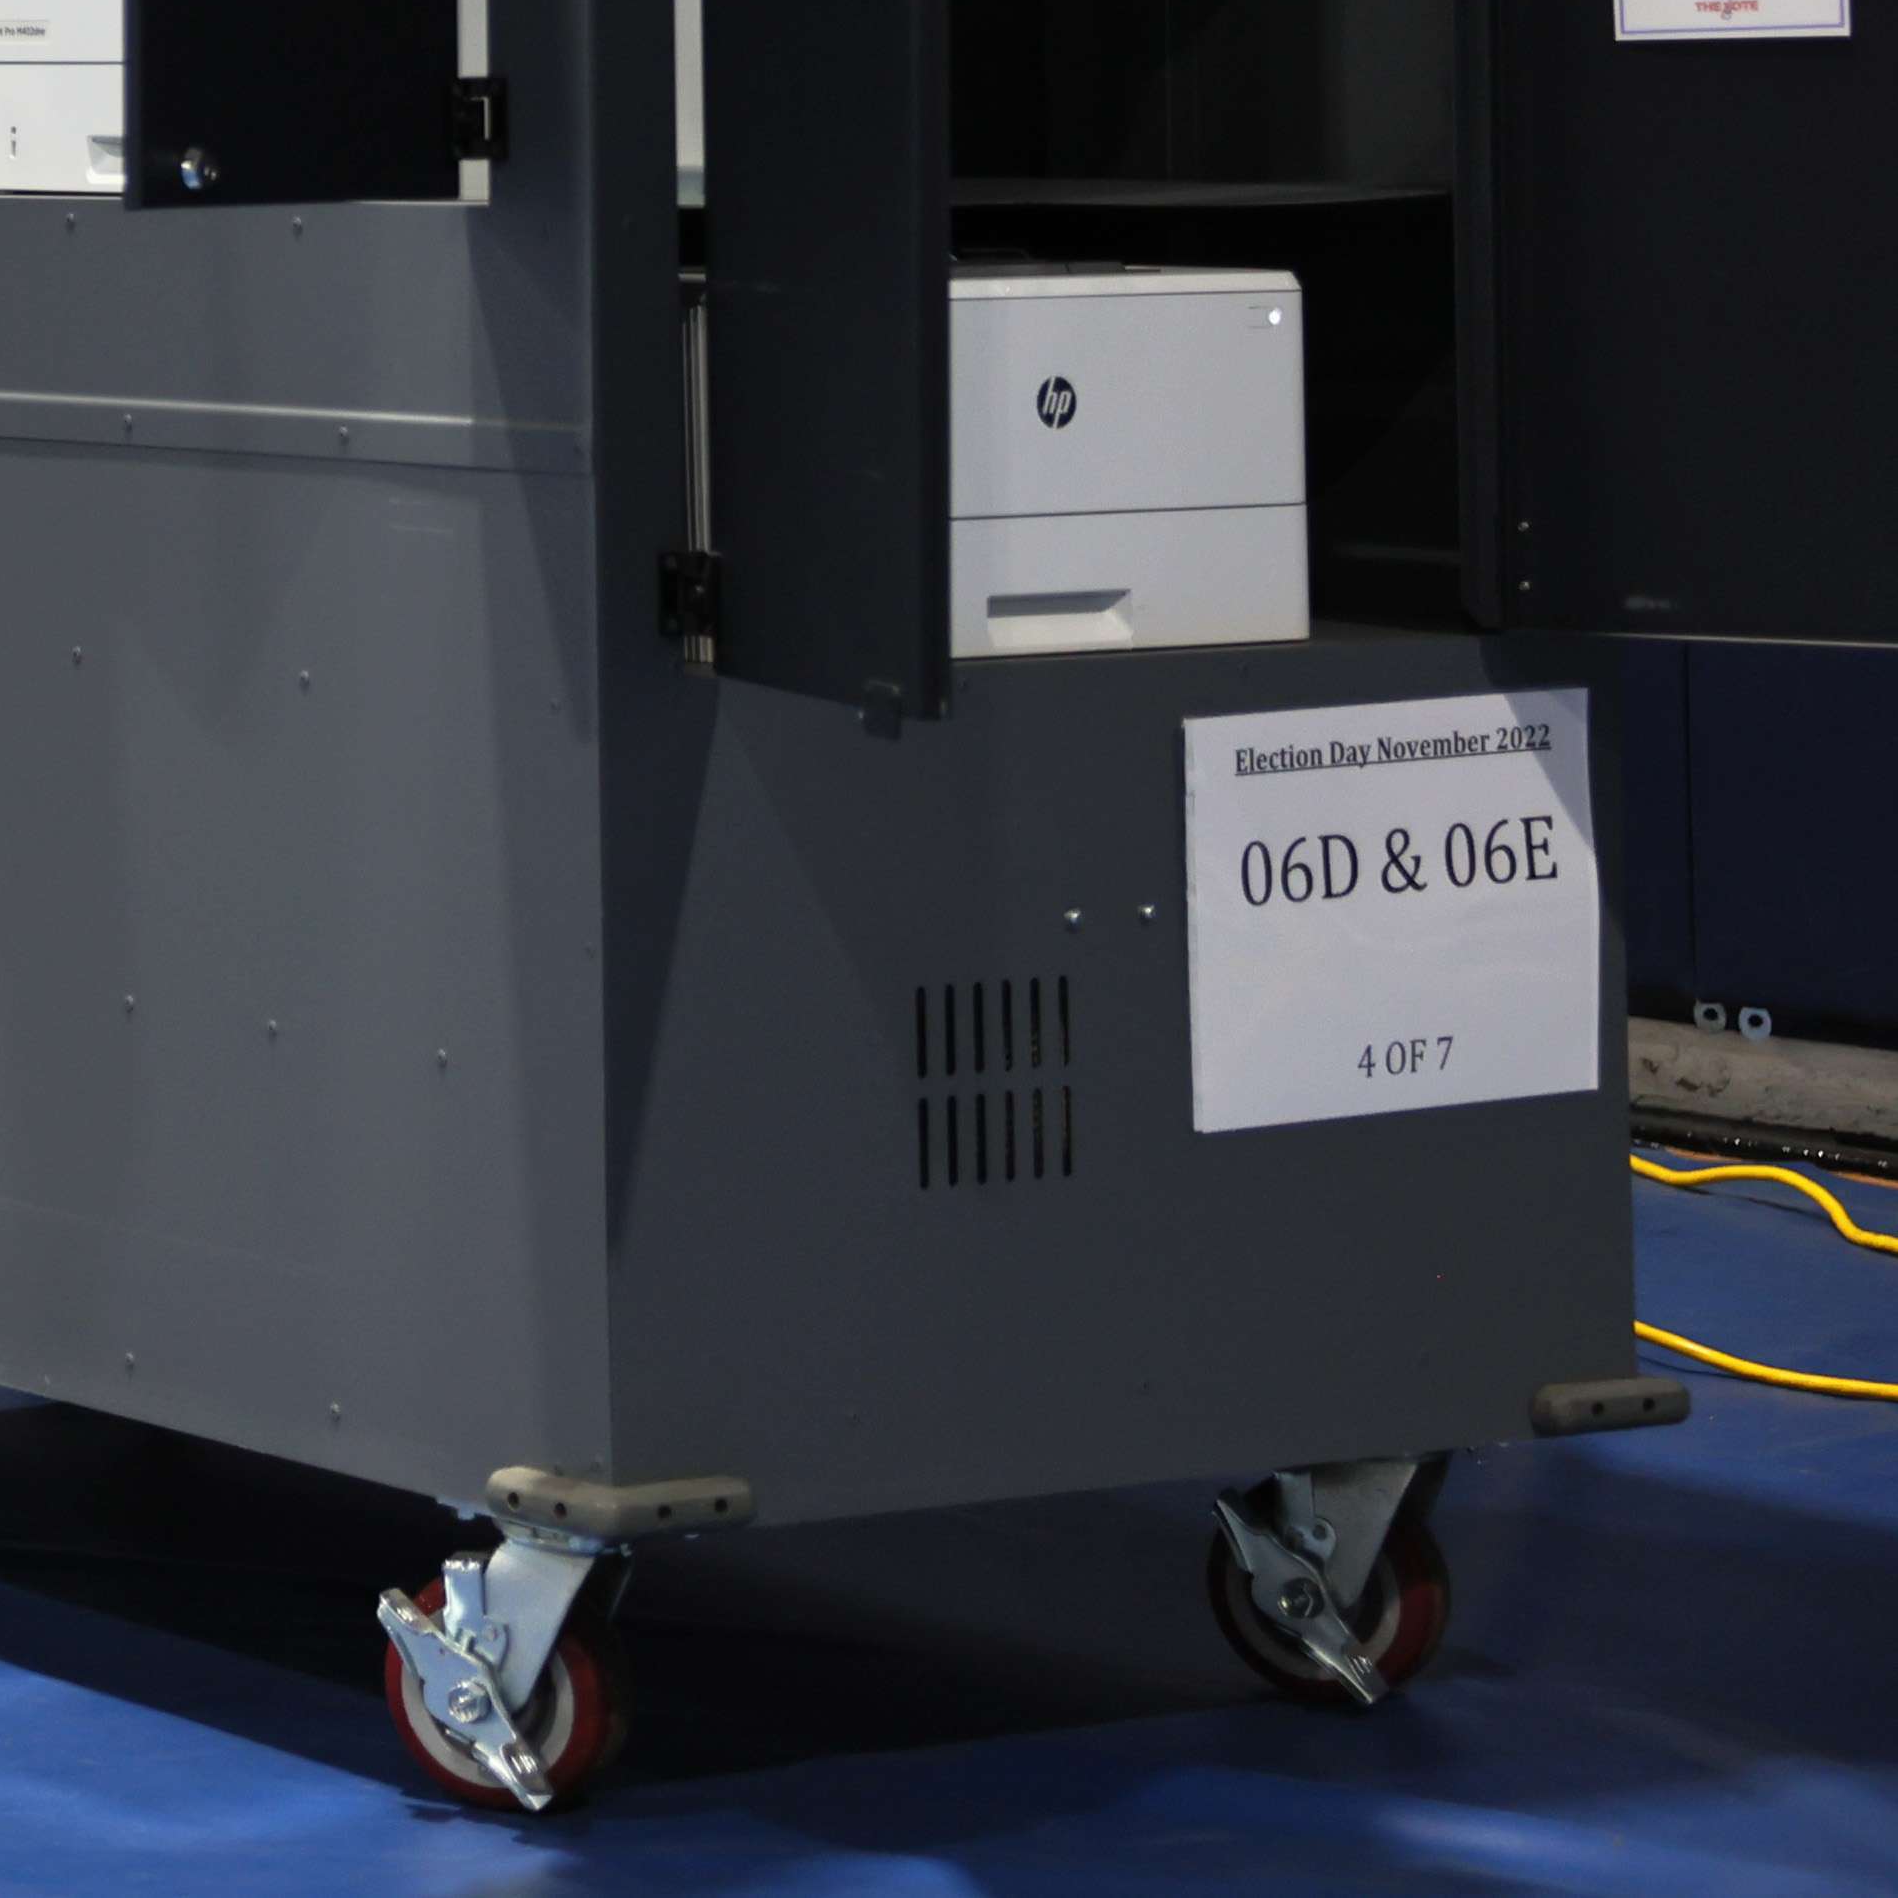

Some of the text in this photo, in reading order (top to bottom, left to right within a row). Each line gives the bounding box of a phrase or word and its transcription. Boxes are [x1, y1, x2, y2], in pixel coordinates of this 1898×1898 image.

[1039, 376, 1075, 429] hp
[1235, 724, 1552, 773] Election Day November 2022
[1241, 815, 1558, 906] 06D & 06E
[1358, 1036, 1453, 1078] 4 OF 7
